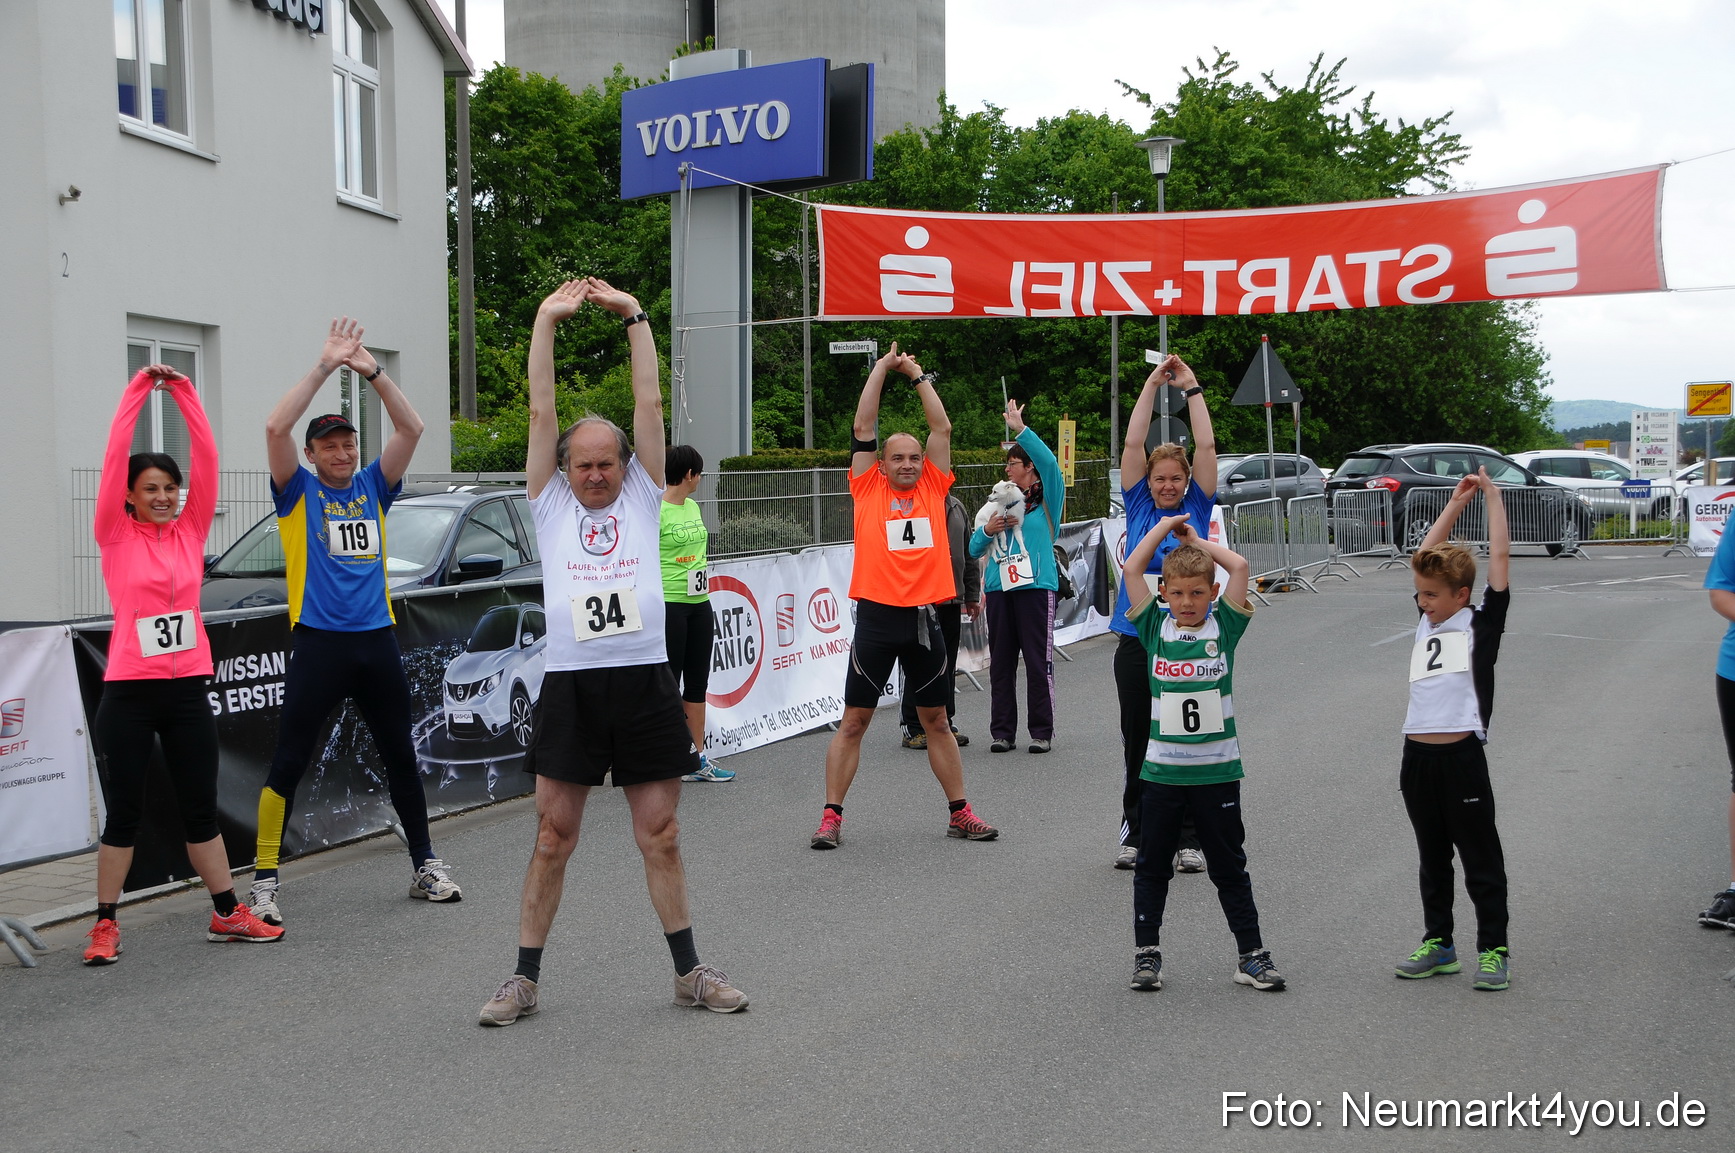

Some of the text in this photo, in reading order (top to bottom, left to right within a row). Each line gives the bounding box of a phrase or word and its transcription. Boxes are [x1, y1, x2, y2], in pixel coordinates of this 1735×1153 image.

[636, 100, 791, 157] VOLVO
[61, 252, 69, 278] 2
[832, 343, 870, 352] Weichselberg
[338, 521, 370, 552] 119
[902, 520, 916, 545] 4
[614, 570, 635, 580] Röschl
[618, 557, 640, 568] HERZ
[1007, 564, 1020, 584] 8
[694, 570, 708, 592] 38
[585, 592, 627, 633] 34
[154, 614, 184, 649] 37
[1178, 634, 1197, 642] JAKO
[772, 651, 804, 671] SEAT
[809, 642, 827, 660] KIA
[1426, 637, 1443, 672] 2
[215, 651, 286, 684] NISSAN
[1154, 660, 1195, 678] ERGO
[225, 682, 286, 713] ERSTE
[721, 717, 761, 748] Sengenthal
[763, 713, 781, 734] Tel.
[780, 700, 820, 728] 09181/26
[818, 694, 839, 714] 80-0
[1181, 698, 1201, 733] 6
[1, 776, 37, 790] VOLKSWAGEN
[37, 771, 66, 783] GRUPPE
